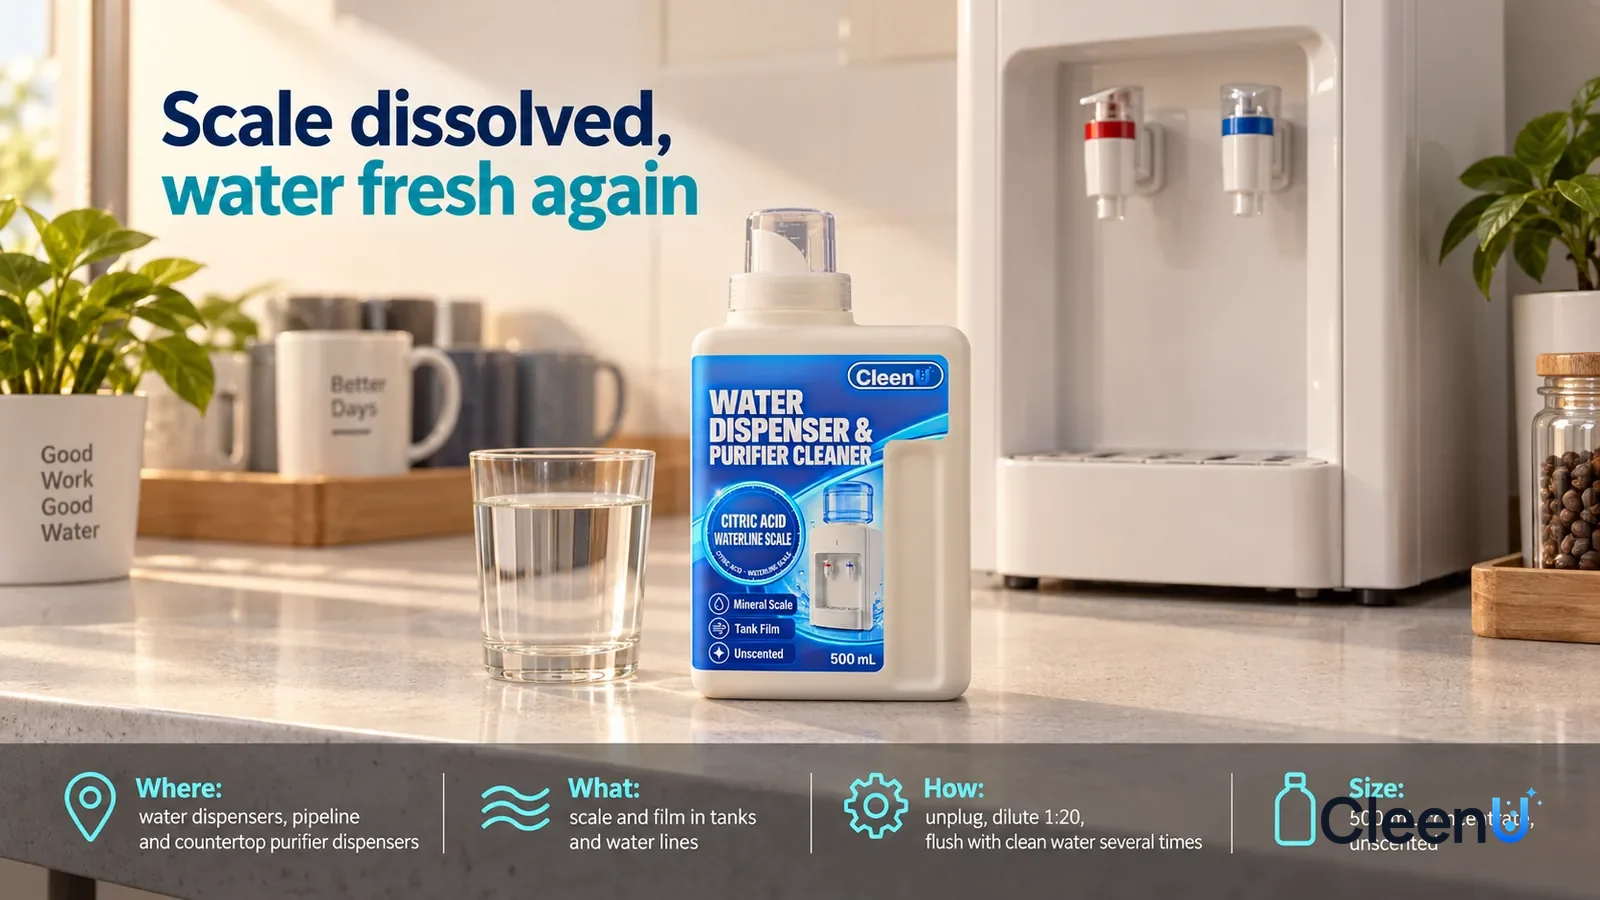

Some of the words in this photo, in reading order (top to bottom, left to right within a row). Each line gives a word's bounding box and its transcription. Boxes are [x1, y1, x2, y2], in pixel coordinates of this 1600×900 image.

[329, 374, 388, 396] Better
[856, 368, 930, 386] CleenU
[329, 397, 380, 422] Days
[709, 389, 804, 415] WATER
[709, 417, 850, 443] DISPENSER
[854, 417, 873, 443] &
[41, 443, 93, 464] Good
[709, 445, 789, 466] PURIFIER
[793, 445, 873, 466] CLEANER
[41, 468, 94, 491] Work
[41, 494, 93, 516] Good
[41, 519, 101, 543] Water
[721, 513, 758, 528] CITRIC
[760, 513, 786, 528] ACID
[714, 532, 763, 546] WATERLINE
[764, 532, 792, 546] SCALE
[733, 599, 767, 610] Mineral
[768, 599, 793, 610] Scale
[734, 623, 758, 634] Tank
[760, 623, 780, 634] Film
[734, 648, 784, 659] Unscented
[830, 653, 855, 665] 500
[857, 653, 876, 665] mL
